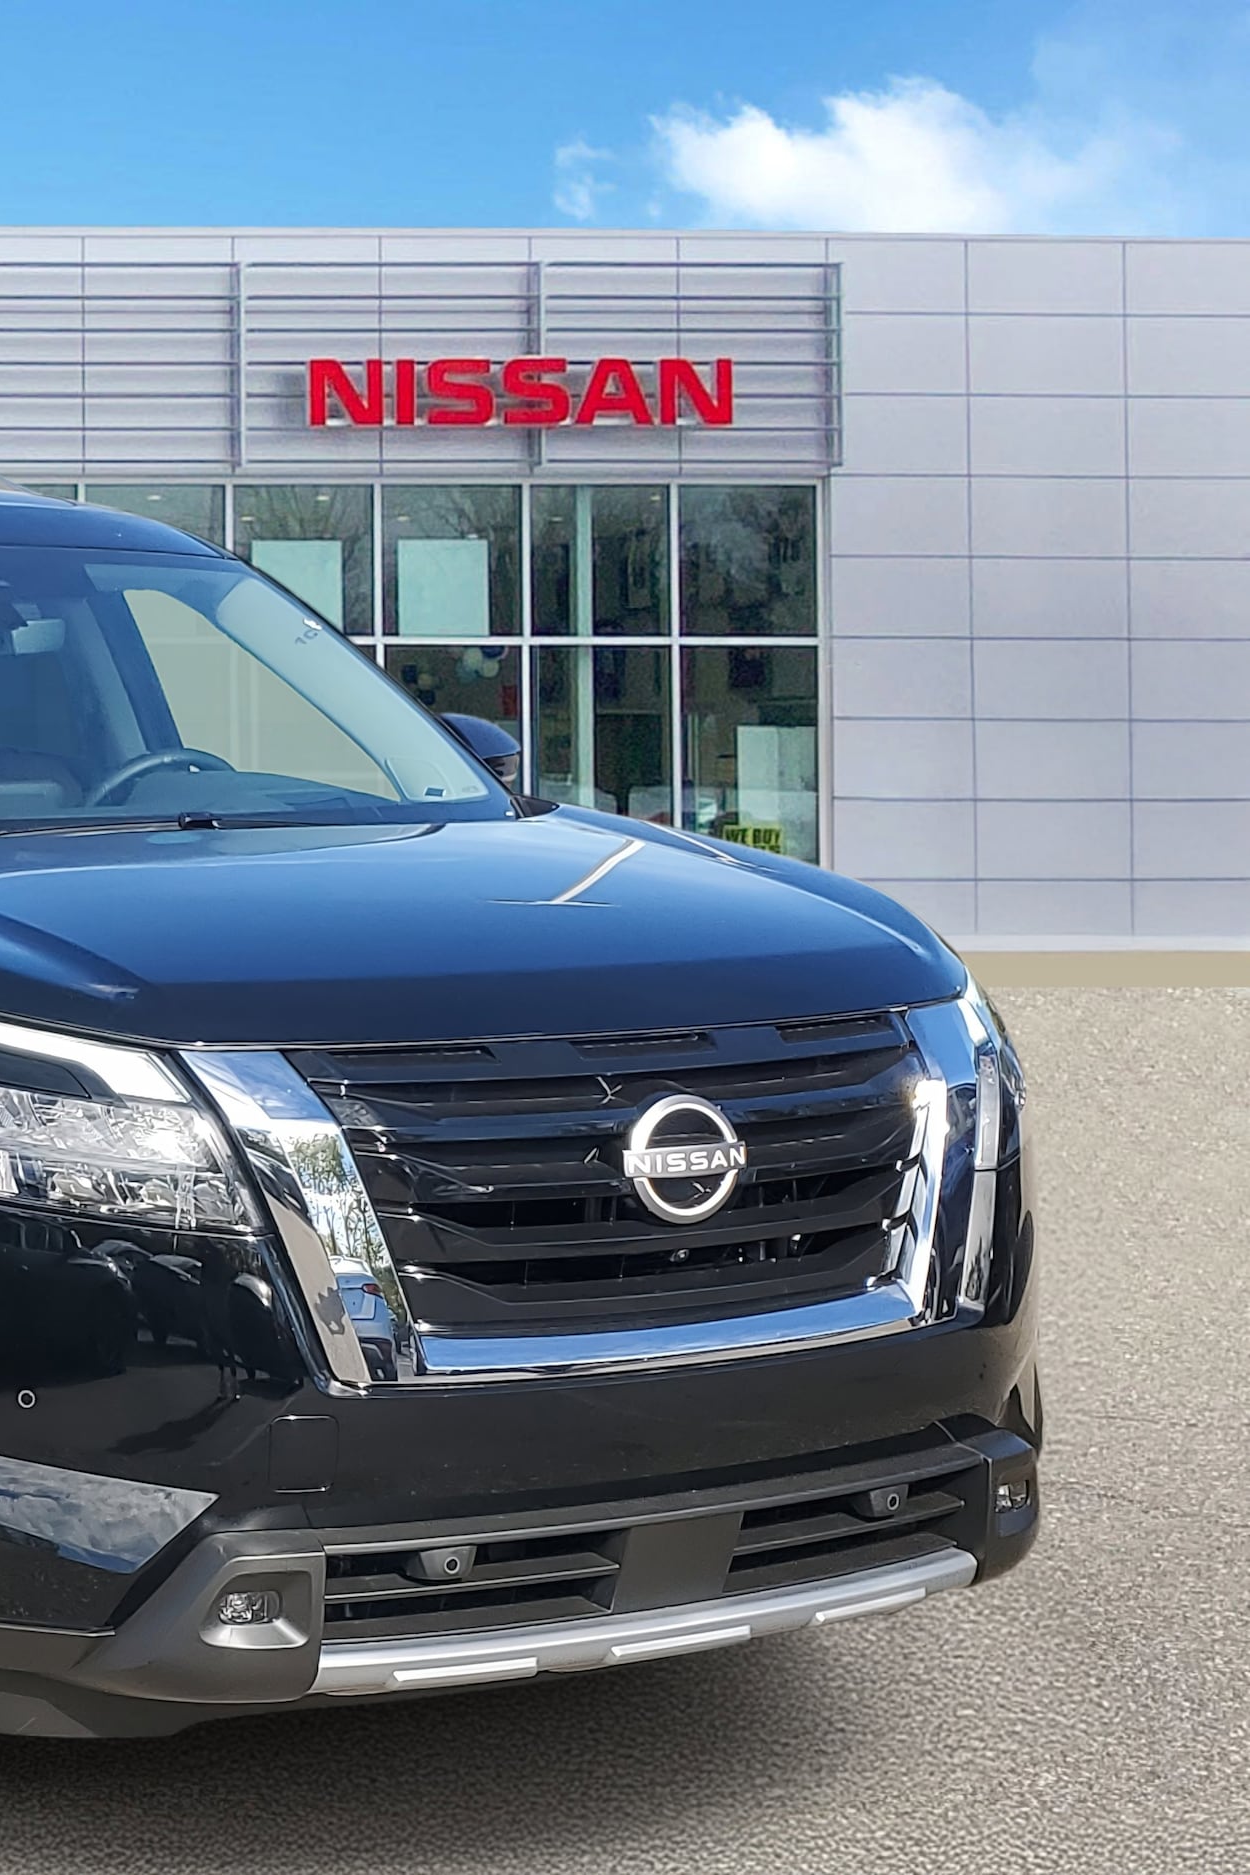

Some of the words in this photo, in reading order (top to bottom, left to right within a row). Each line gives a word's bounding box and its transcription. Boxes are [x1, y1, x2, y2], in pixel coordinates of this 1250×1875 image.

[308, 357, 733, 427] NISSAN
[724, 828, 748, 844] WE
[752, 828, 781, 845] BUY
[628, 1146, 745, 1174] NISSAN
